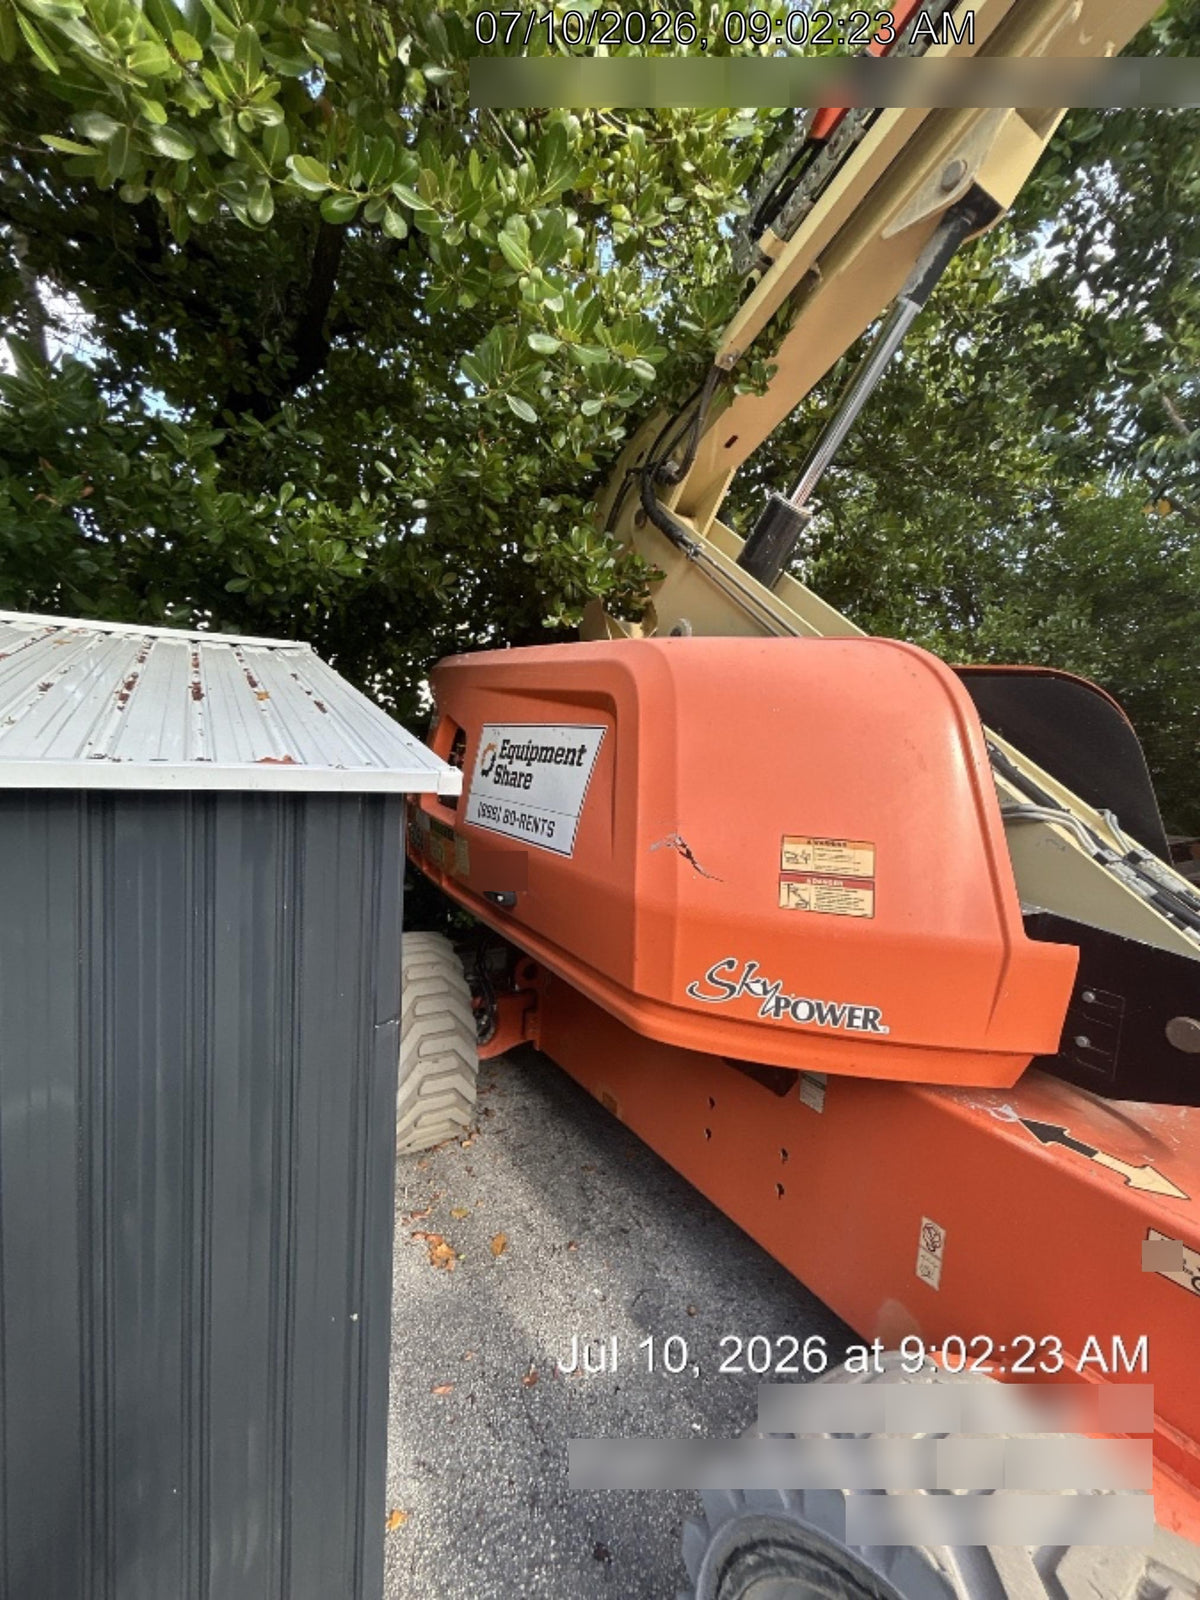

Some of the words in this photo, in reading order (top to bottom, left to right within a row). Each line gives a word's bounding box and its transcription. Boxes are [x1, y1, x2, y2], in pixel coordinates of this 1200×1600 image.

[499, 739, 587, 767] Equipment
[493, 764, 533, 790] Share
[502, 808, 556, 838] 80-RENTS
